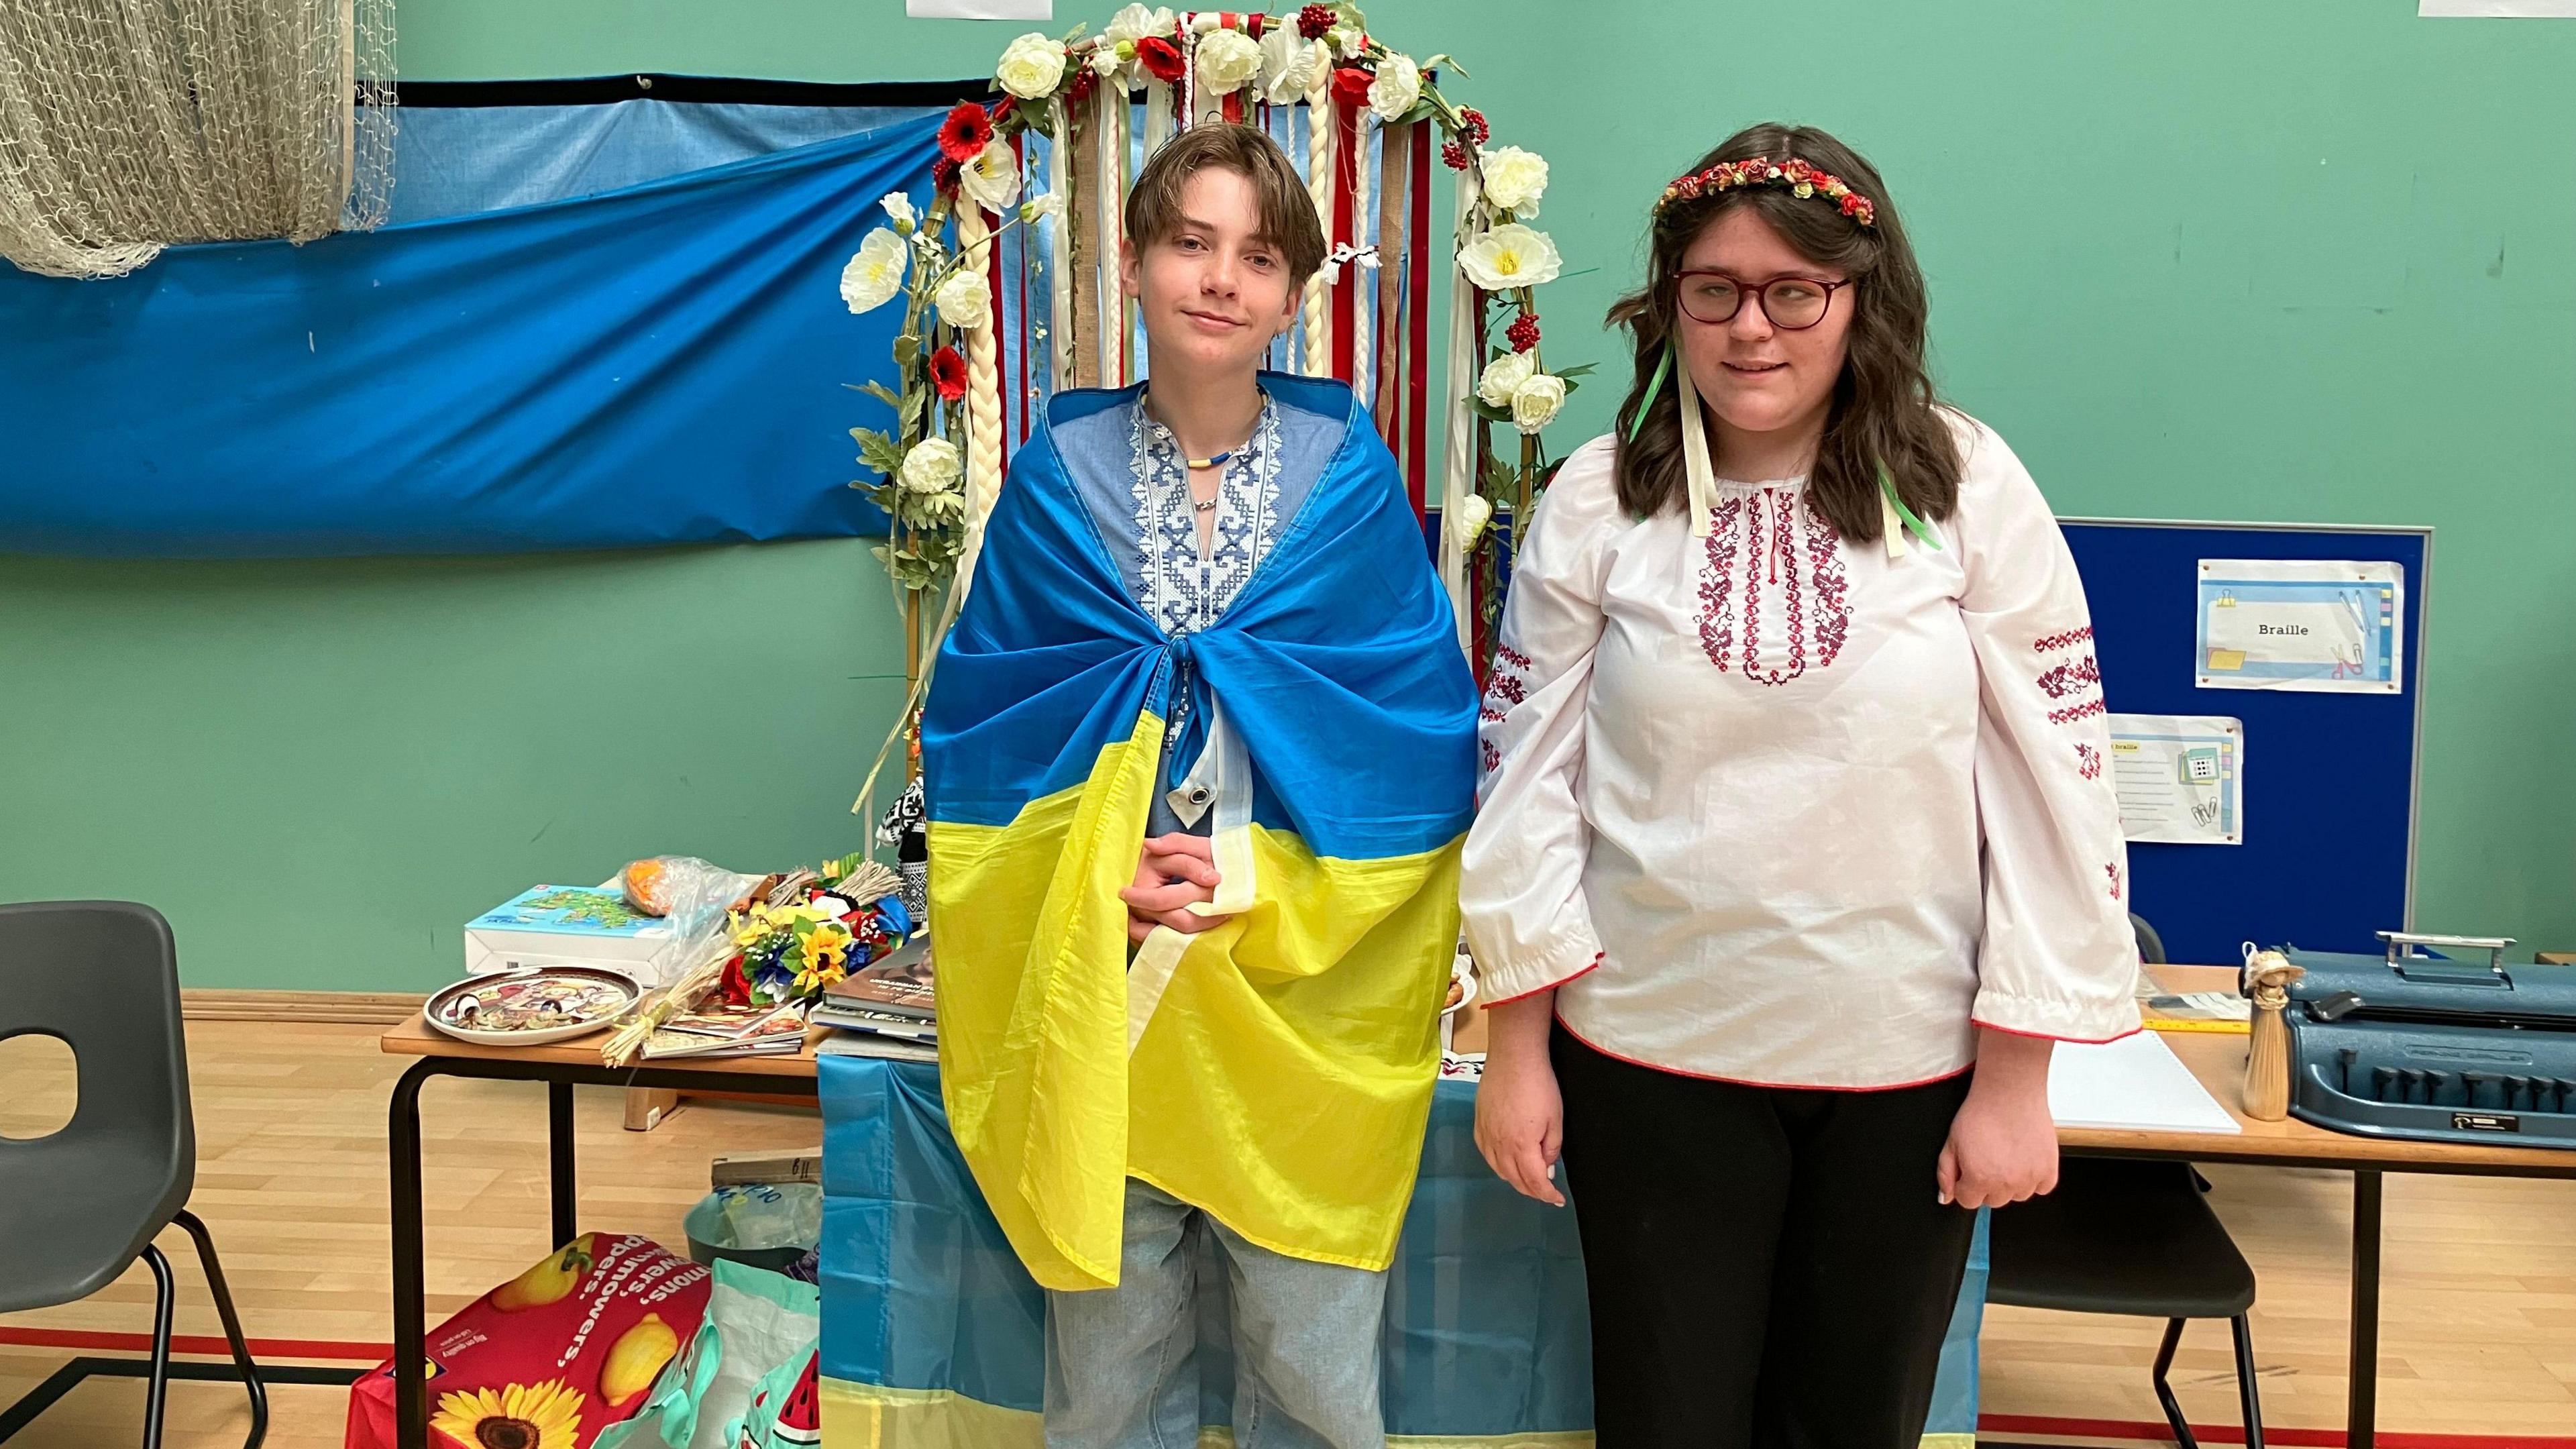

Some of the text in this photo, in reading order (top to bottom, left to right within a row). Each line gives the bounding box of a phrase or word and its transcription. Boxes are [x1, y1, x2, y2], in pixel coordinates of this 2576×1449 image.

[2259, 625, 2308, 635] Braille
[579, 1236, 647, 1300] ppers.
[639, 1265, 712, 1305] mons,
